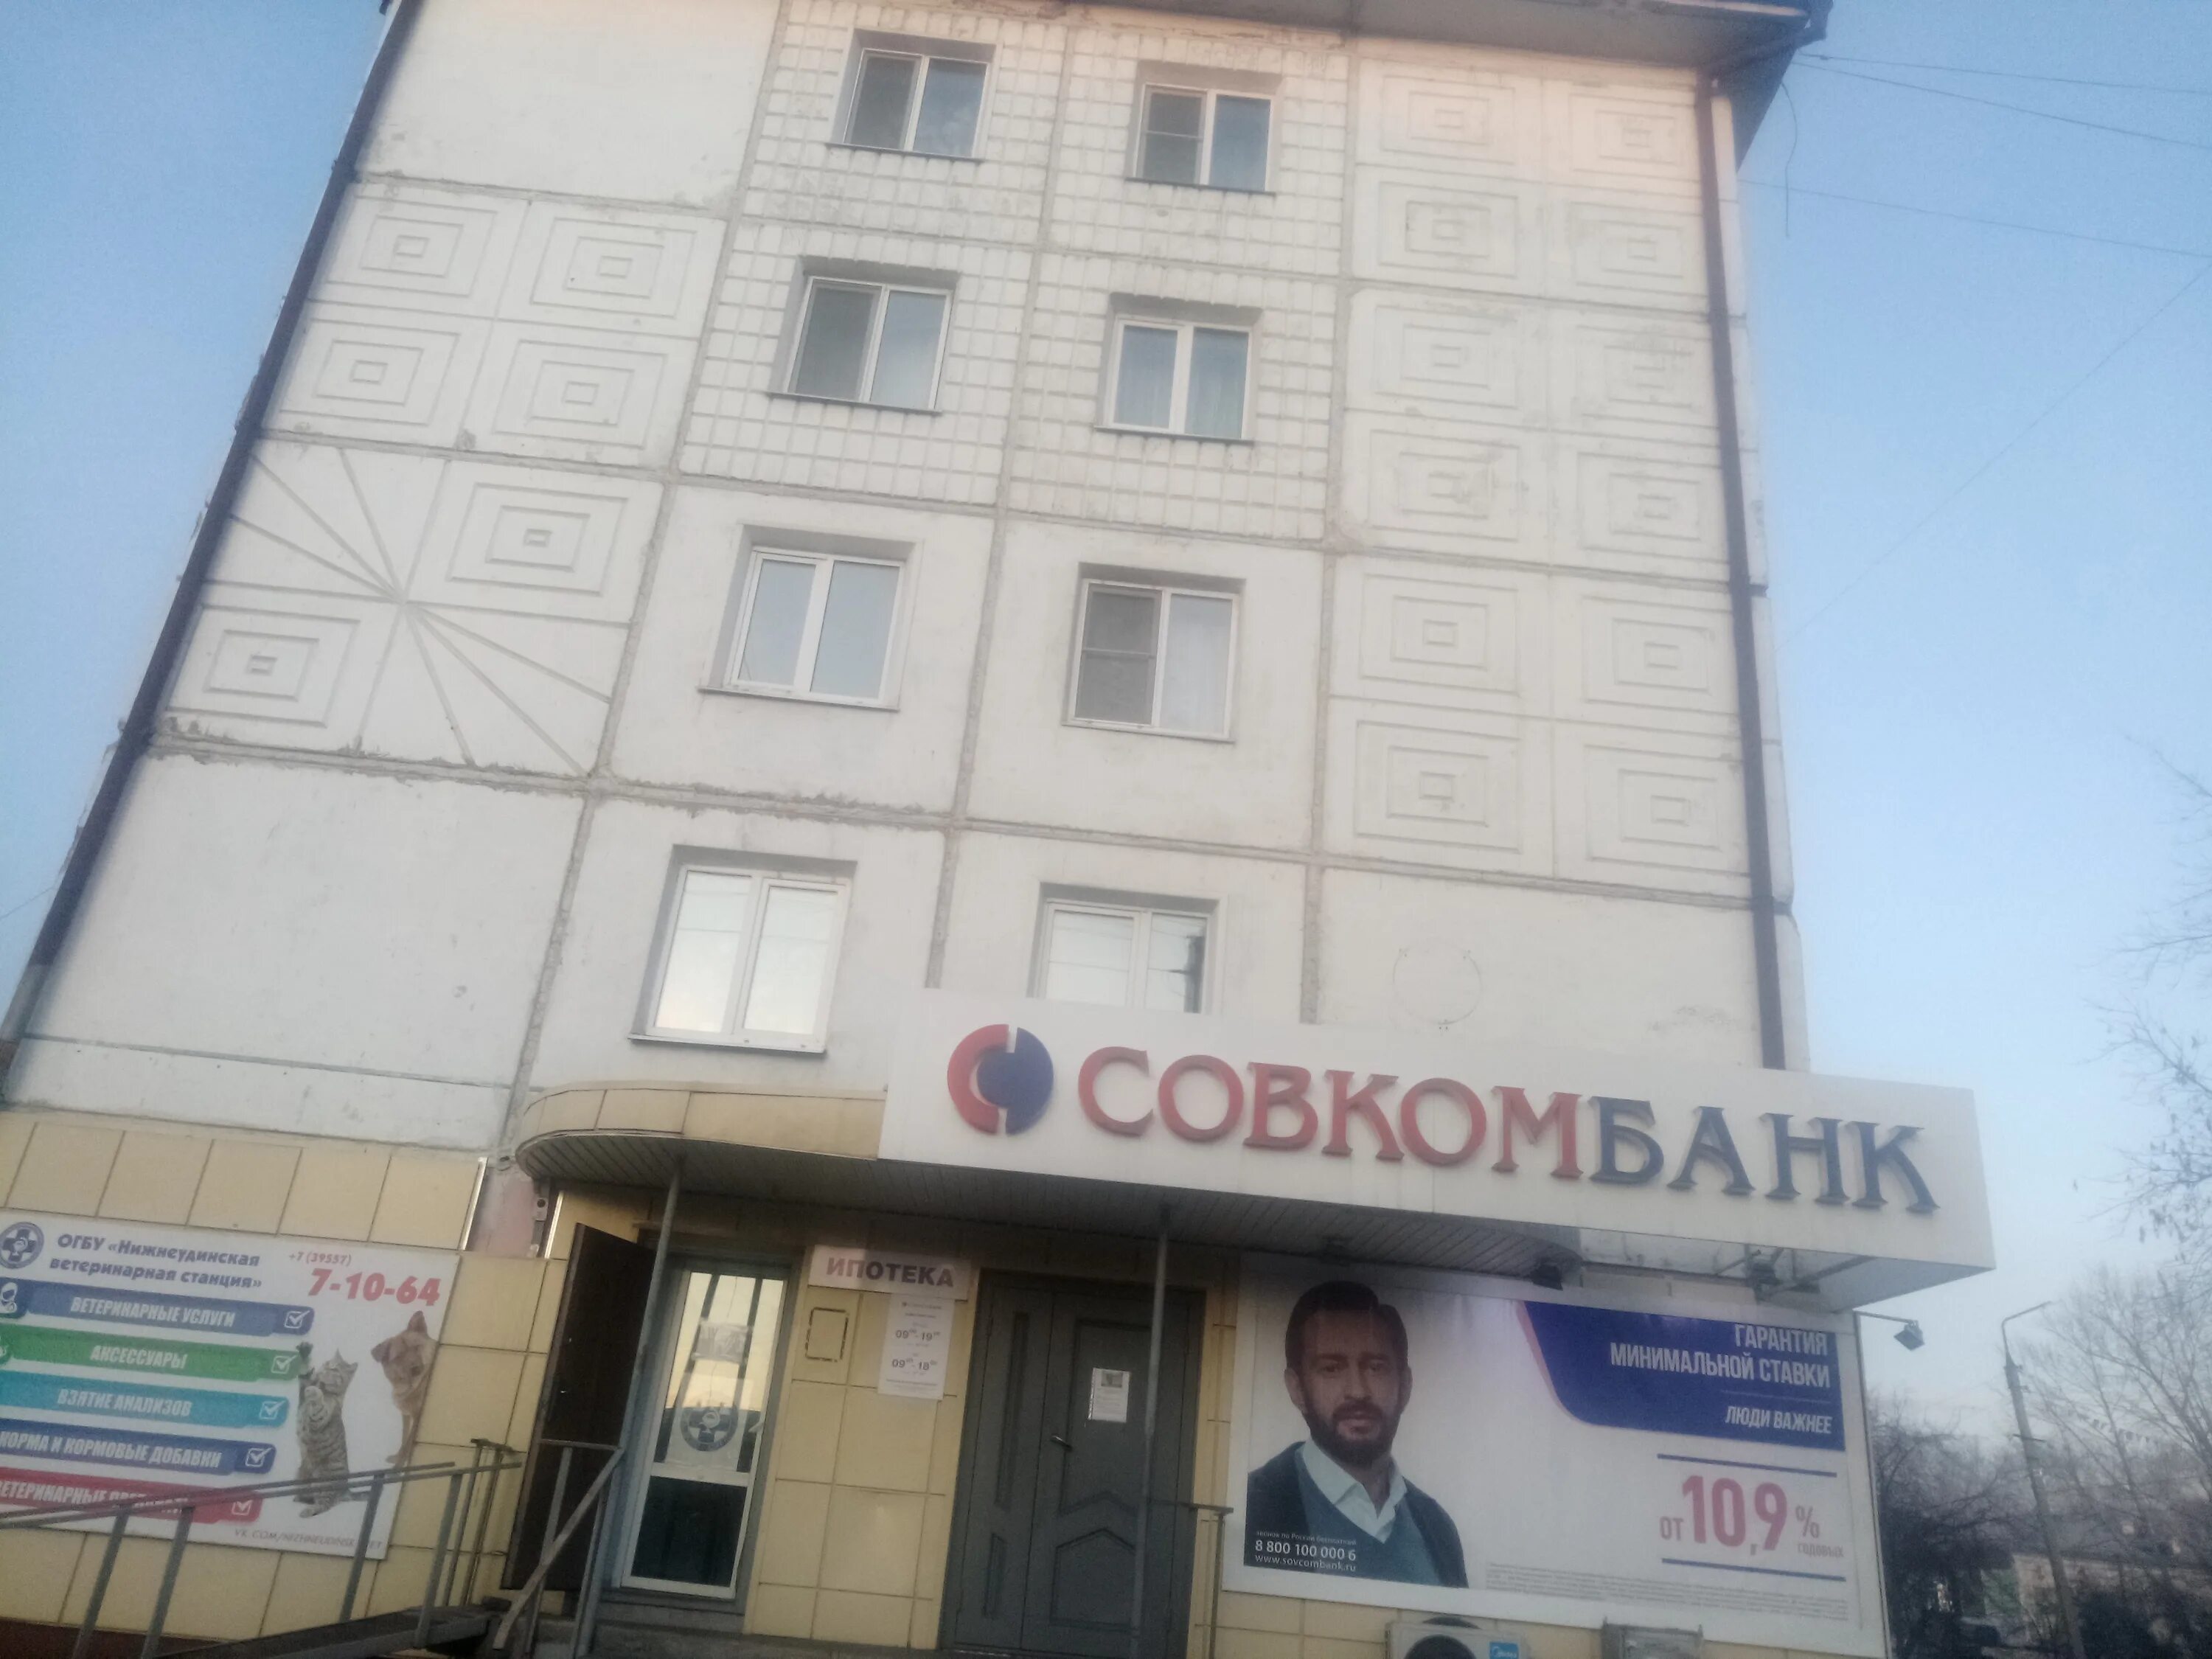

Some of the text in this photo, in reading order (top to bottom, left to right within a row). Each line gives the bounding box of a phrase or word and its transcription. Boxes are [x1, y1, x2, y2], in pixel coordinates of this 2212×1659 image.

[1077, 1046, 1940, 1215] СОВКОМБАНК
[58, 1234, 260, 1267] ОГБУ «Нижнеудинская
[289, 1251, 352, 1267] +7 (39557)
[49, 1258, 262, 1288] ветеринарная станция»
[308, 1268, 441, 1306] 7-10-64
[827, 1257, 953, 1287] ИПОТЕКА
[70, 1296, 236, 1327] ВЕТЕРИНАРНЫЕ УСЛУГИ
[1735, 1324, 1827, 1355] ГАРАНТИЯ
[89, 1345, 188, 1369] АКСЕССУАРЫ
[1610, 1342, 1830, 1388] МИНИМАЛЬНОЙ СТАВКИ
[57, 1388, 193, 1416] ВЗЯТИЕ АНАЛИЗОВ
[1725, 1405, 1833, 1434] ЛЮДИ ВАЖНЕЕ
[50, 1436, 63, 1453] И
[63, 1437, 150, 1461] КОРМОВЫЕ
[149, 1444, 223, 1468] ДОБАВКИ
[1682, 1475, 1787, 1556] 10,9
[1795, 1505, 1820, 1539] %
[1255, 1540, 1357, 1561] 8 800 100 000 6
[1255, 1554, 1357, 1572] www.sovcombank.ru
